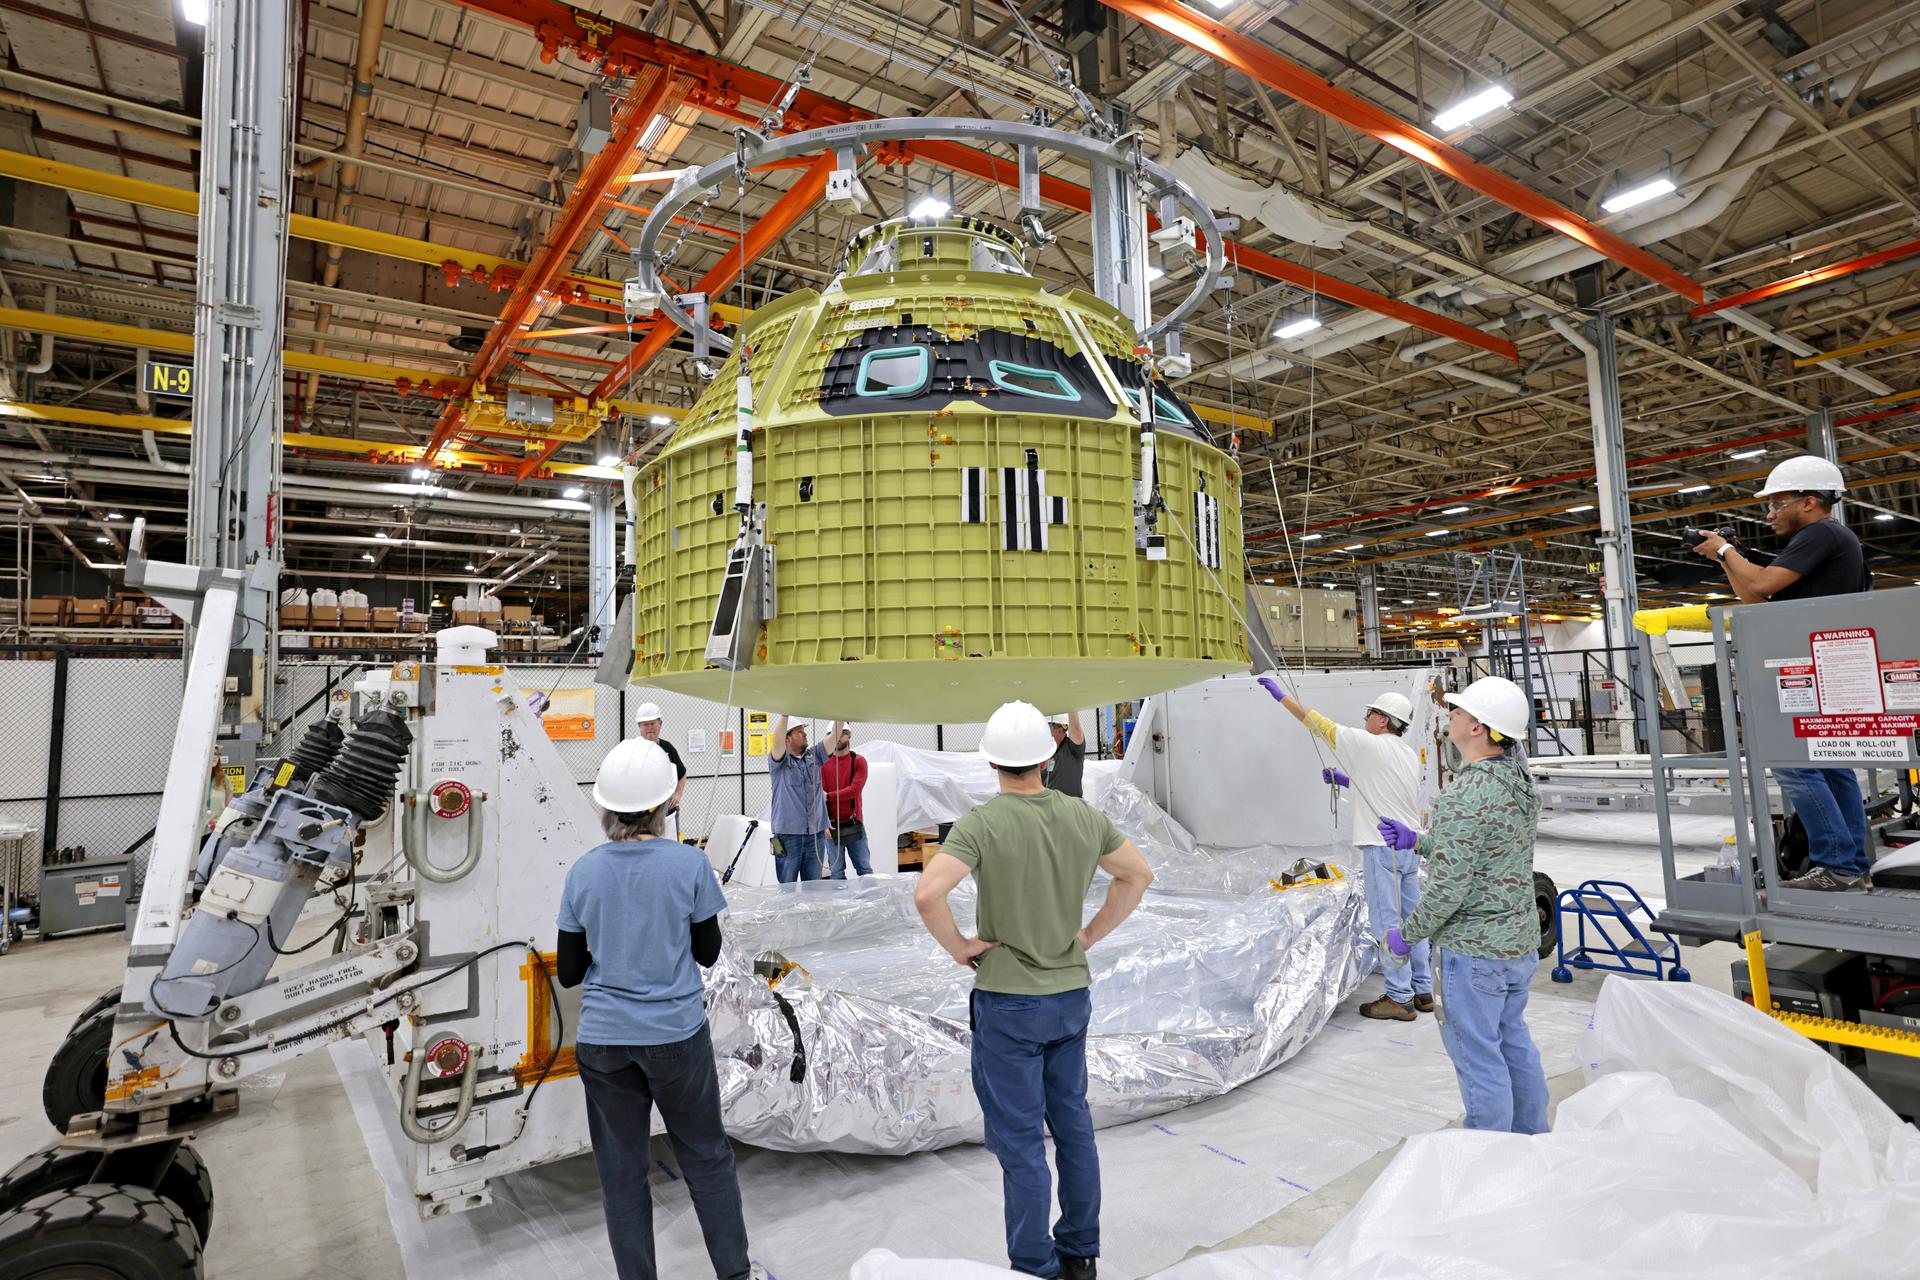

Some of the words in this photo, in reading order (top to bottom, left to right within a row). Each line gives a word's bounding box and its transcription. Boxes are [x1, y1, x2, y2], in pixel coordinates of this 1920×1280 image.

[153, 365, 190, 393] N-9
[1589, 561, 1601, 573] N-7
[1823, 629, 1870, 640] WARNING
[1890, 673, 1917, 681] DANGER
[1817, 740, 1838, 748] LOAD
[1839, 740, 1851, 748] ON
[1813, 750, 1857, 758] EXTENSION
[1862, 750, 1904, 758] INCLUDED
[222, 767, 242, 775] TION
[283, 983, 304, 994] KEEP
[308, 973, 334, 986] HANDS
[338, 965, 357, 976] FREE
[284, 986, 316, 1000] DURING
[319, 969, 364, 988] OPERATION
